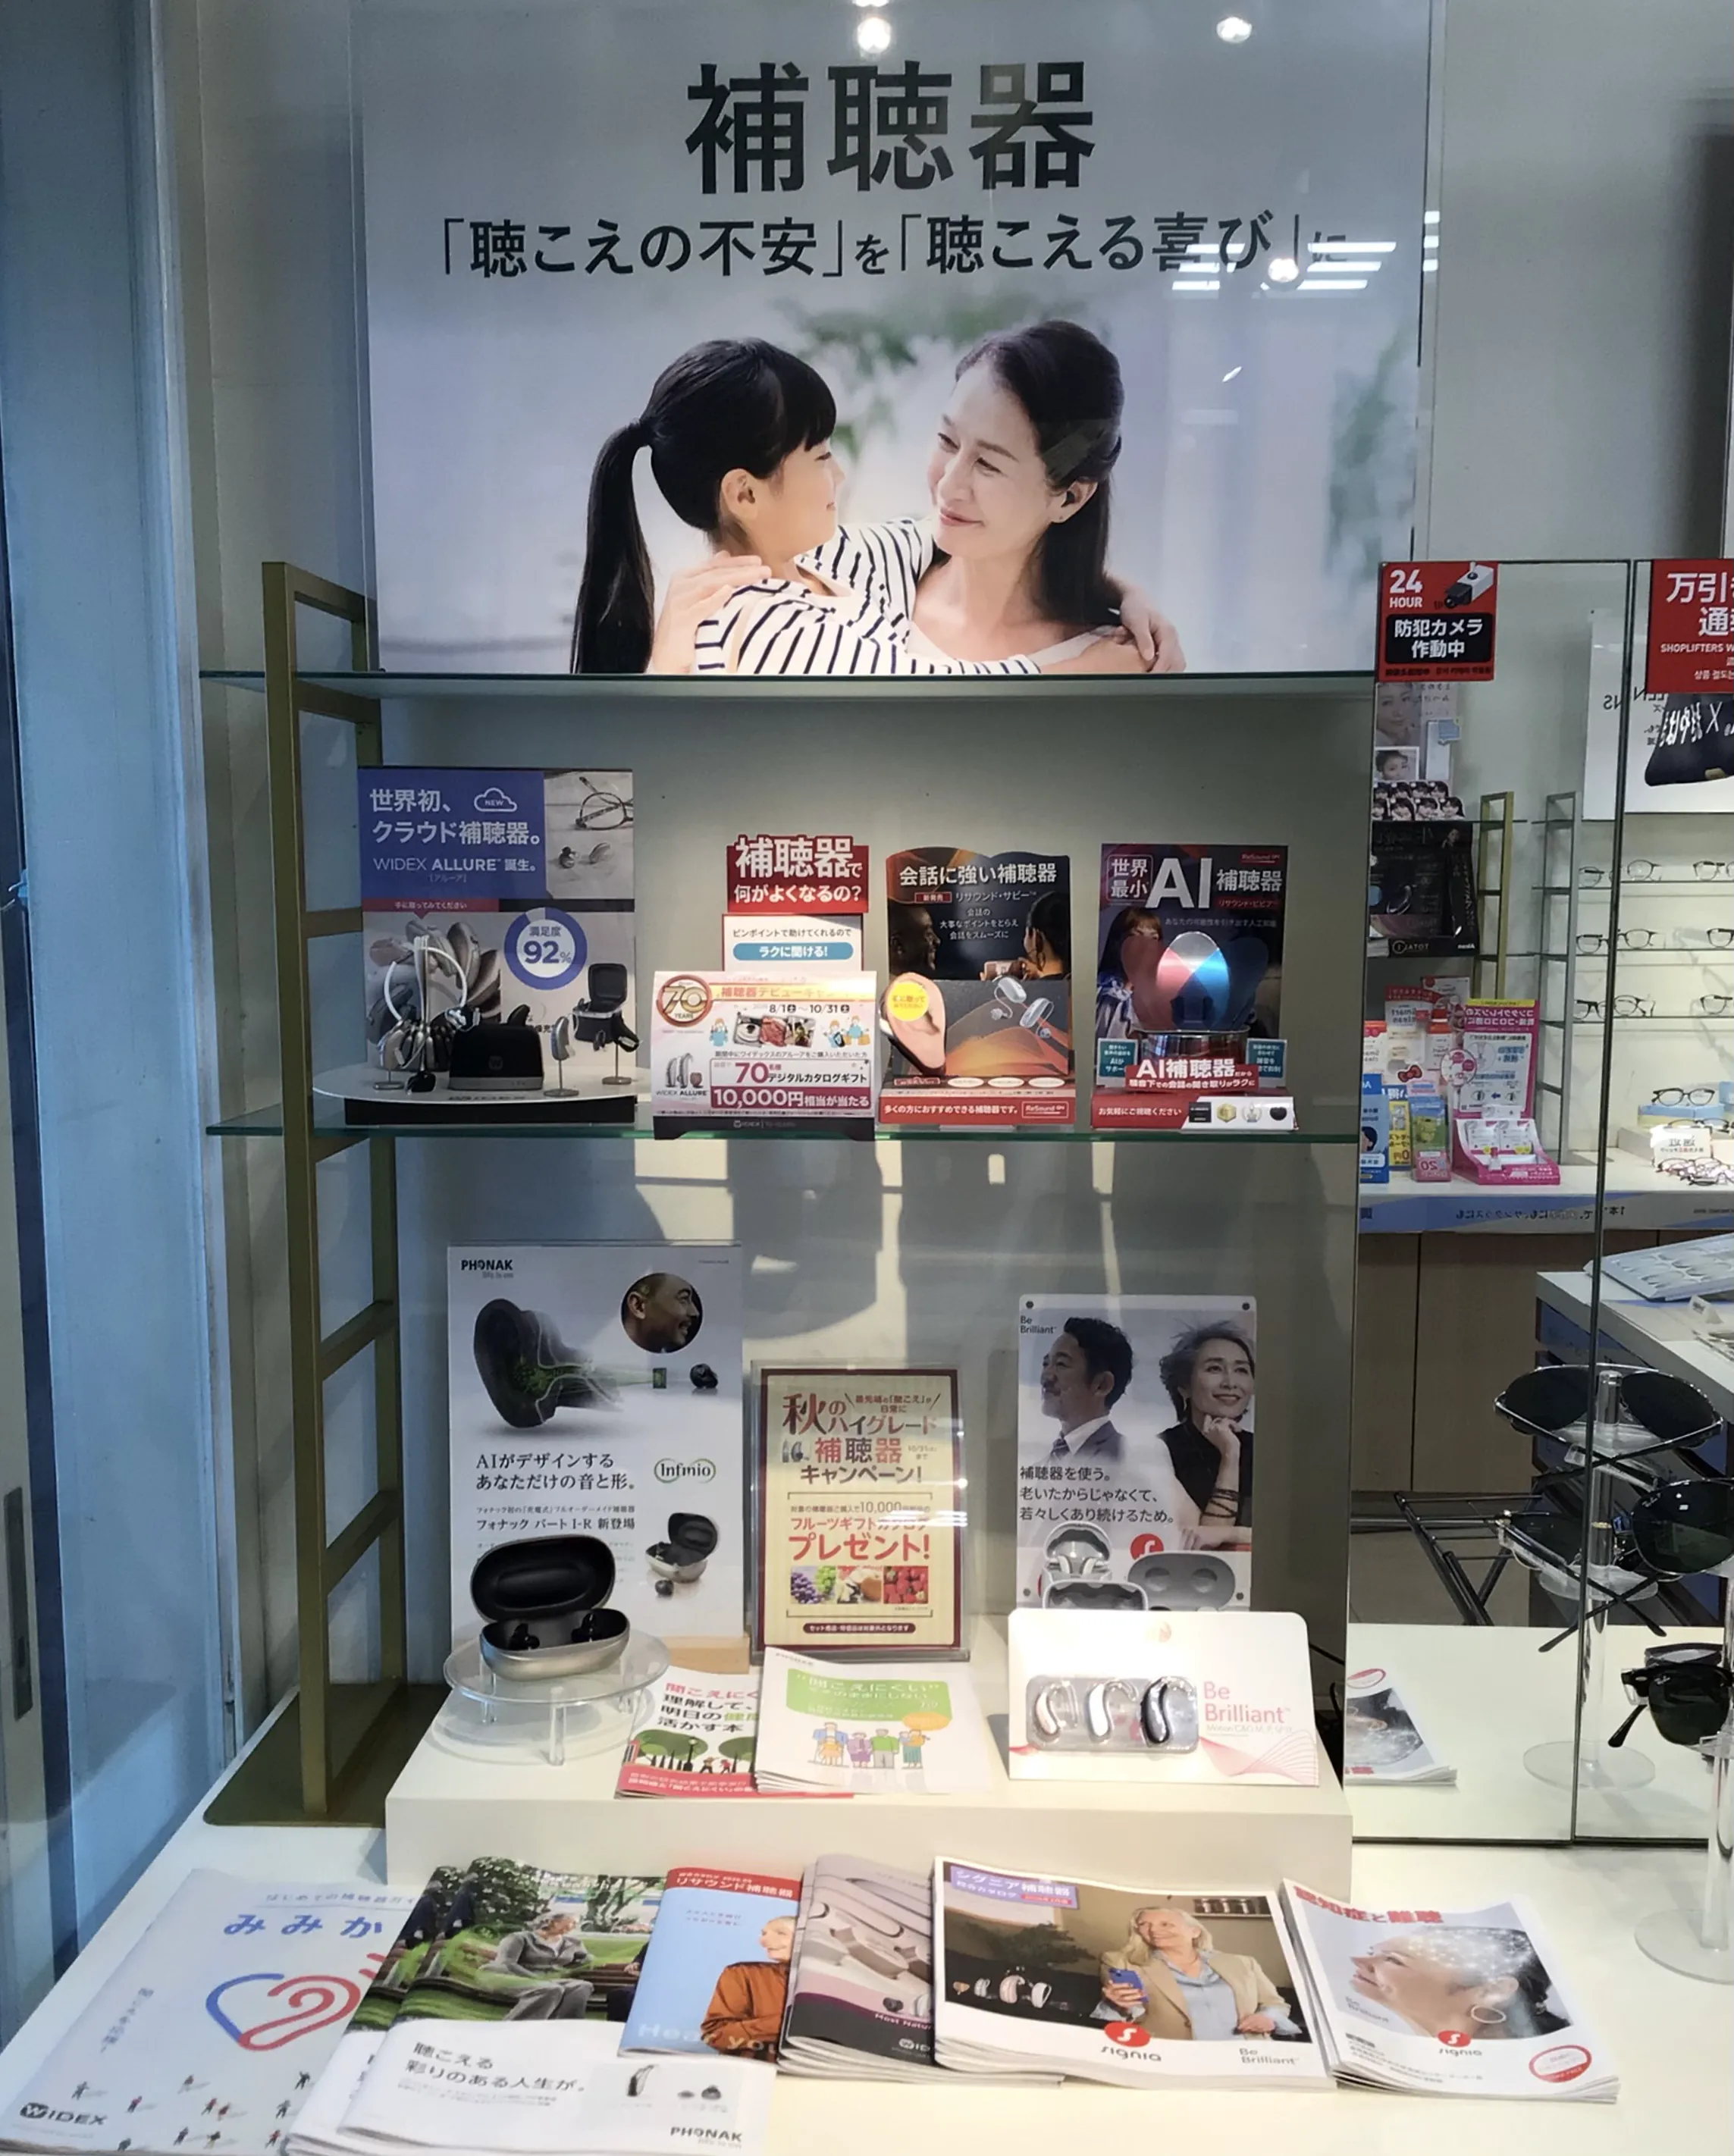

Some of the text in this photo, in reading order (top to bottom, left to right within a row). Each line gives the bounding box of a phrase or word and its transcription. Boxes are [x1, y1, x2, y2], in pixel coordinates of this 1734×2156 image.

[685, 60, 1096, 194] 補聴器
[1389, 569, 1423, 594] 24
[1666, 572, 1734, 603] 万引
[1389, 597, 1422, 608] HOUR
[1394, 619, 1483, 638] 防犯カメラ
[1698, 606, 1734, 637] 通
[1411, 640, 1465, 659] 作動中
[1660, 643, 1724, 653] SHOPLIFTERS
[369, 788, 451, 813] 世界初、
[372, 820, 541, 845] クラウド補聴器。
[373, 857, 428, 870] WIDEX
[504, 858, 536, 872] 誕生。
[735, 836, 862, 879] 補聴器で
[899, 863, 1057, 886] 会話に強い補聴器
[1111, 858, 1148, 877] 世界
[1111, 879, 1148, 898] 最小
[1145, 857, 1212, 909] AI
[1216, 869, 1283, 892] 補聴器
[734, 884, 861, 903] 何がよくなるの?
[967, 908, 990, 917] 会話の
[528, 926, 561, 937] 満足度
[732, 927, 851, 938] ピンポイントで助けてくれるので
[939, 920, 1019, 929] 大事なポイントをとらえ
[949, 931, 1009, 940] 会話をスムーズに
[522, 941, 572, 964] 92%
[759, 945, 828, 958] ラクに聞ける!
[1136, 1058, 1253, 1080] AI補聴器だから
[769, 1073, 867, 1084] デジタルカタログギフト
[1129, 1079, 1256, 1089] 騒音下での会話の聞き取りがラクに
[714, 1089, 869, 1108] 10,000円相当が当たる
[884, 1104, 1018, 1114] 多くの方におすすめできる補聴器です。
[461, 1259, 513, 1271] PHONAK
[1021, 1315, 1032, 1324] Be
[880, 1405, 908, 1413] 日常に
[827, 1415, 938, 1435] ハイグレード
[814, 1437, 902, 1464] 補聴器
[475, 1454, 614, 1469] AIがデザインする
[475, 1474, 635, 1490] あなただけの音と形。
[800, 1465, 922, 1485] キャンペーン!
[1020, 1465, 1111, 1482] 補聴器を使う。
[1020, 1486, 1158, 1502] 老いたからじゃなくて、
[476, 1518, 529, 1531] フォナック
[597, 1518, 635, 1530] 新登場
[1019, 1508, 1174, 1523] 若々しくあり続けるため。
[789, 1533, 930, 1562] プレゼント!
[1203, 1680, 1230, 1700] Be
[663, 1693, 752, 1711] 理解して、
[657, 1716, 744, 1732] 活かす本
[676, 1876, 794, 1898] リサウンド補聴器
[955, 1870, 1071, 1897] シグニア補聴器
[875, 2013, 899, 2025] Most
[412, 2041, 494, 2070] 聴こえる
[1101, 2047, 1162, 2063] signia
[1239, 2048, 1258, 2056] Be
[1438, 2047, 1482, 2059] signia
[403, 2060, 585, 2091] 彩りのある人生が。
[20, 2101, 108, 2126] WIDEX
[670, 2126, 742, 2142] PHONAK
